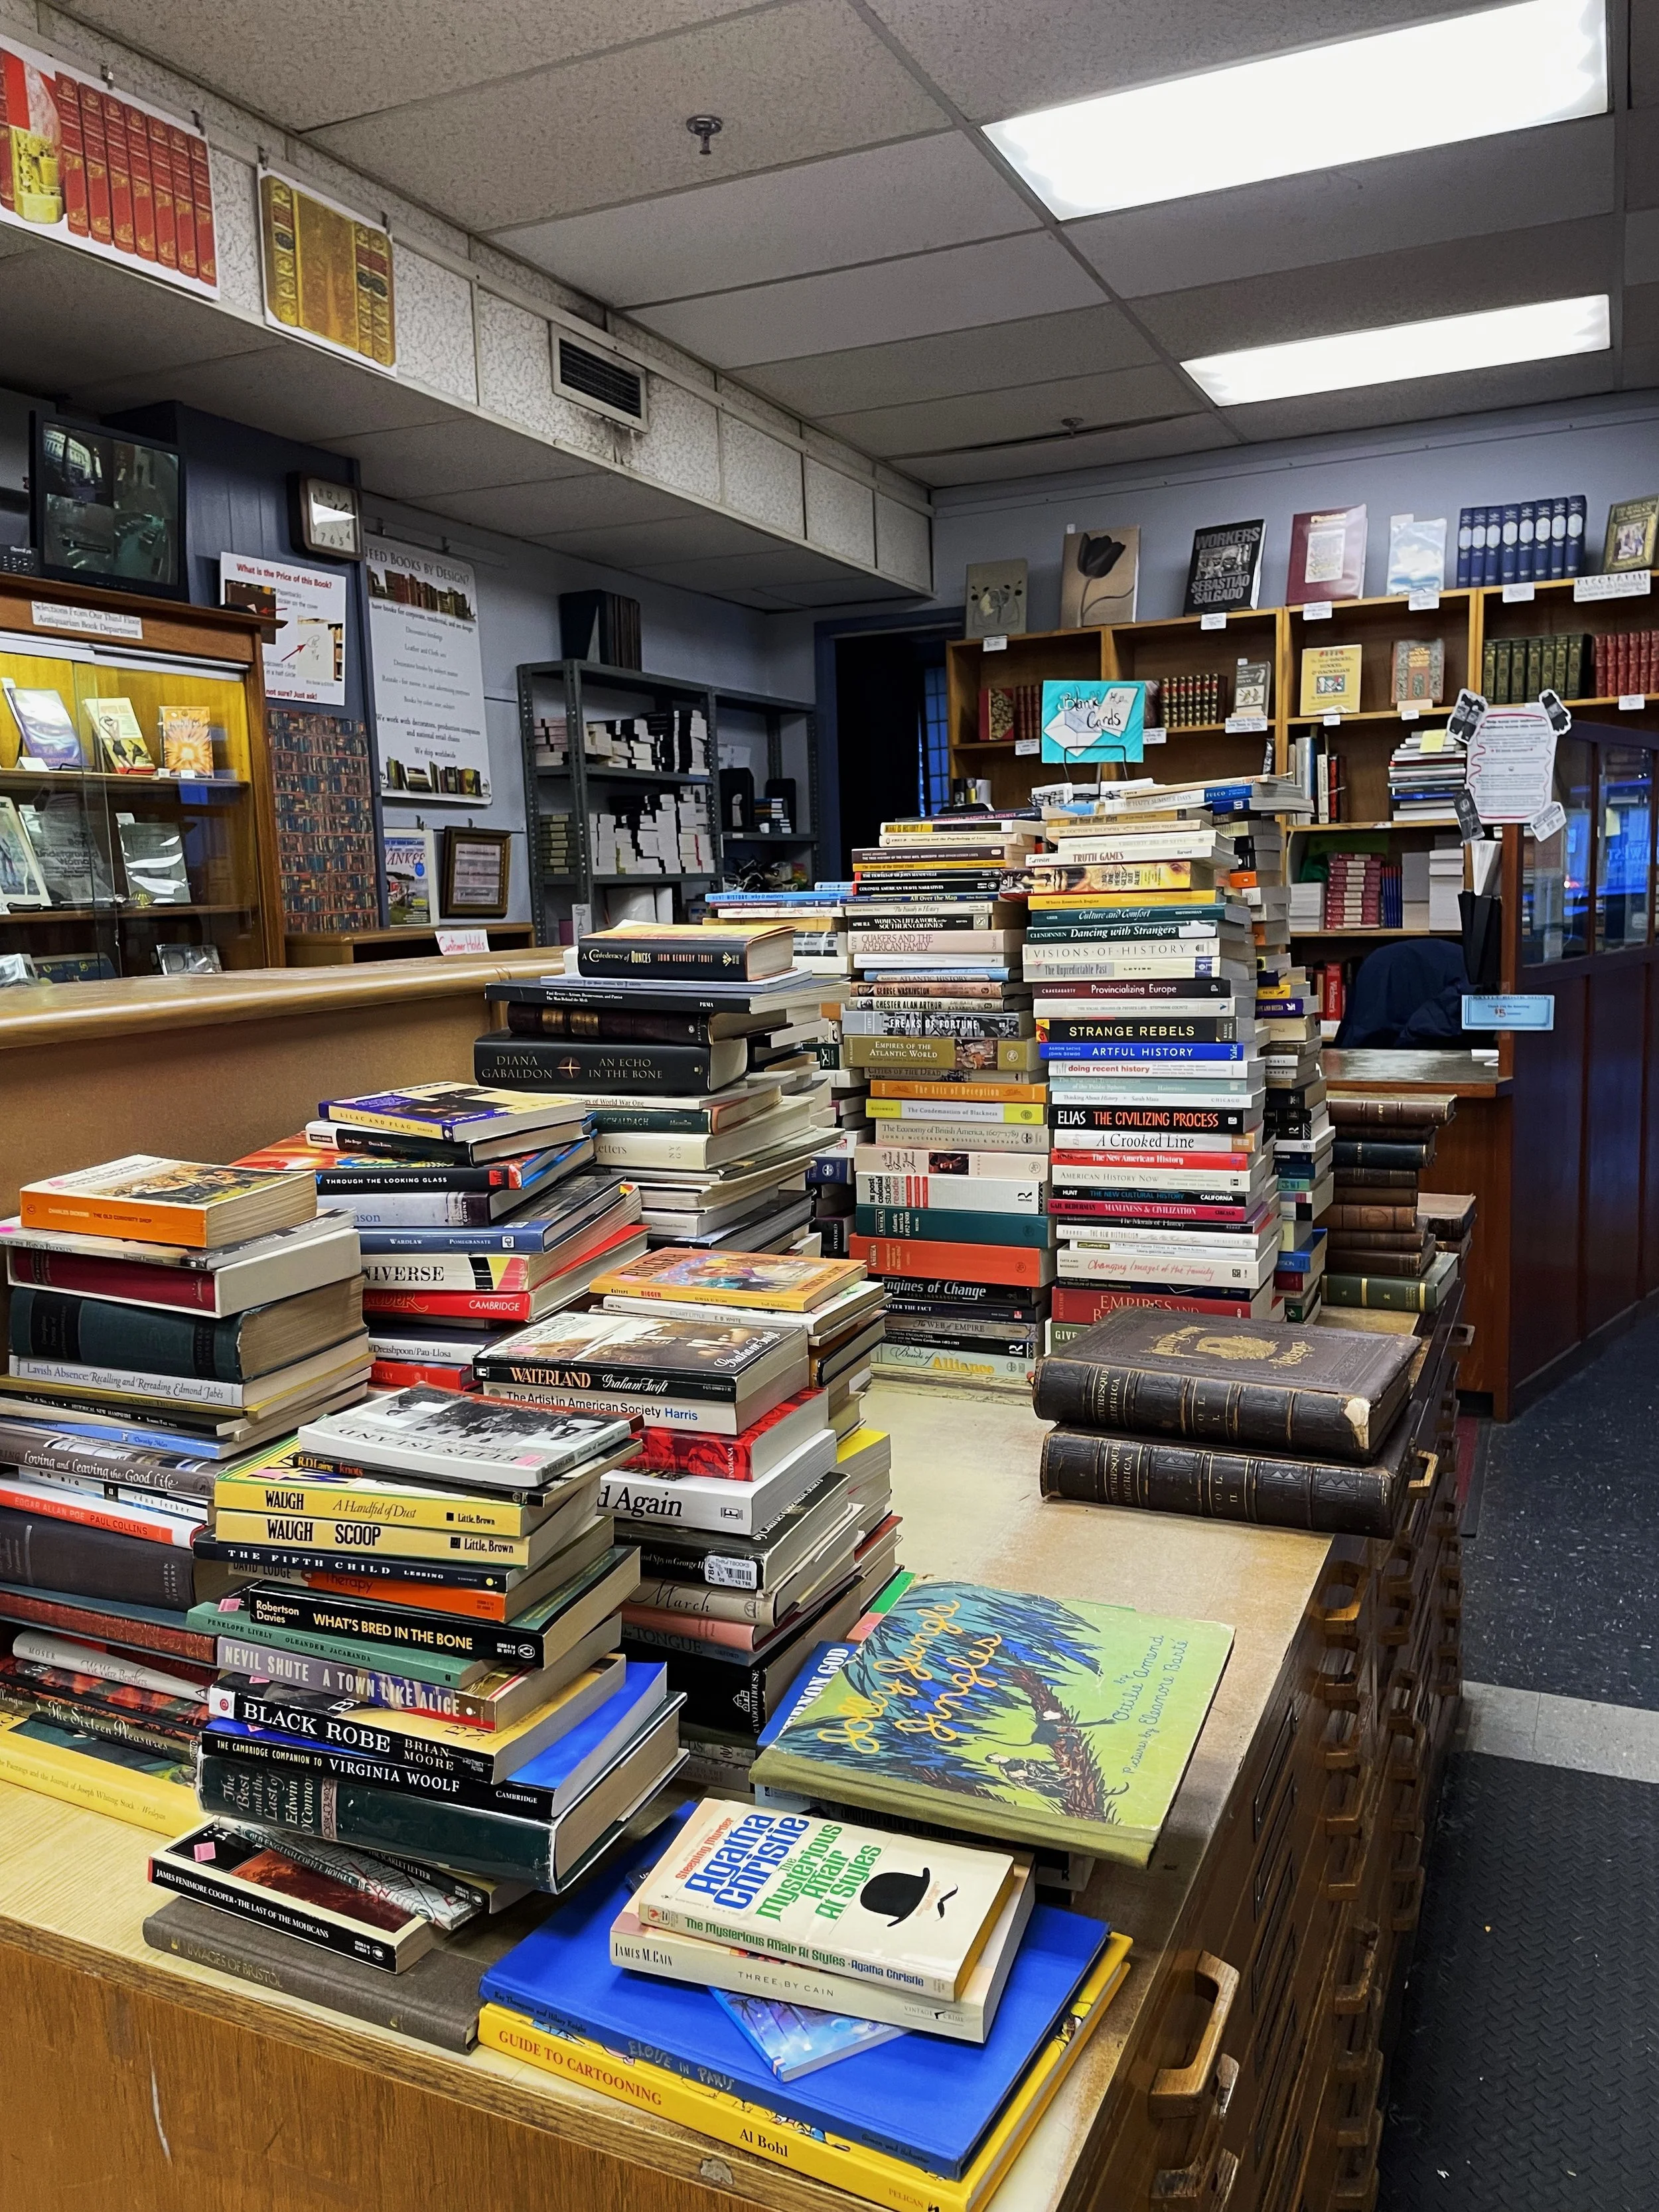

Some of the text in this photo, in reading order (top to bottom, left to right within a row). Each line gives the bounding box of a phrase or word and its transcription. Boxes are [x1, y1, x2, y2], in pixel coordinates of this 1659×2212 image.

[1195, 527, 1261, 550] WORKERS
[237, 563, 255, 574] What
[264, 569, 274, 577] the
[276, 571, 291, 581] Price
[301, 576, 313, 585] this
[315, 579, 331, 589] Book?
[391, 552, 421, 571] BOOKS
[437, 565, 469, 585] DESIGN?
[1193, 587, 1244, 605] SALGADO
[38, 615, 138, 635] Antiquarian Book Department
[1087, 709, 1121, 728] Cards
[1073, 851, 1123, 862] TRUTH GAMES
[861, 934, 896, 943] QUAKERS
[917, 934, 933, 942] THE
[1070, 926, 1177, 938] Dancing with Strangers
[439, 934, 484, 952] Customer Holds
[863, 942, 930, 951] AMERICAN FAMILY
[1091, 984, 1177, 995] Provincializing Europe
[876, 1001, 901, 1009] CHESTER
[919, 1001, 942, 1009] ARTHUR
[889, 1019, 978, 1029] FREAKS OF FORTUNE
[1069, 1026, 1194, 1037] STRANGE REBELS
[496, 1056, 538, 1066] DIANA
[599, 1058, 652, 1067] AN ECHO
[481, 1068, 553, 1078] GABALDON
[589, 1069, 663, 1078] IN THE BONE
[1057, 1111, 1086, 1125] ELIAS
[1094, 1112, 1218, 1128] THE CIVILIZING PROCESS
[1096, 1134, 1194, 1148] A Crooked Line
[883, 1278, 986, 1299] Engines of Change
[469, 1300, 520, 1311] CAMBRIDGE
[931, 1357, 995, 1374] Alliance
[510, 1367, 668, 1393] WATERLAND Graham Swift
[506, 1391, 698, 1420] The Artist in American Society Harris
[265, 1490, 304, 1510] WAUGH
[618, 1487, 682, 1517] Again
[15, 1497, 147, 1535] EDGAR ALLAN POE PAUL COLLINS
[267, 1518, 381, 1546] WAUGH SCOOP
[465, 1538, 513, 1553] Little, Brown
[228, 1550, 391, 1574] THE FIFTH CHILD
[628, 1581, 711, 1612] March
[256, 1600, 299, 1616] Robertson
[256, 1611, 286, 1624] Davies
[313, 1613, 472, 1651] WHAT'S BRED IN THE BONE
[224, 1645, 309, 1682] NEVIL SHUTE
[323, 1672, 460, 1718] A TOWN LIKE ALICE
[1139, 1676, 1175, 1725] Eleanore
[243, 1702, 390, 1753] BLACK ROBE
[403, 1739, 449, 1757] BRIAN
[403, 1751, 454, 1771] MOORE
[329, 1759, 460, 1793] VIRGINIA WOOLF
[685, 1814, 776, 1895] Agatha
[714, 1816, 810, 1909] Christie
[755, 1824, 843, 1922] Mysterious
[801, 1851, 852, 1900] Affair
[156, 1870, 234, 1903] JAMES FENIMORE COOPER
[238, 1898, 329, 1939] THE LAST OF THE MOHICANS
[685, 1917, 924, 1987] The Mysterious Affair At Styles Agatha Christie
[739, 1971, 778, 1984] THREE
[805, 1984, 834, 1996] CAIN
[498, 2030, 662, 2105] GUIDE TO CARTOONING
[739, 2130, 789, 2157] Al Bohl
